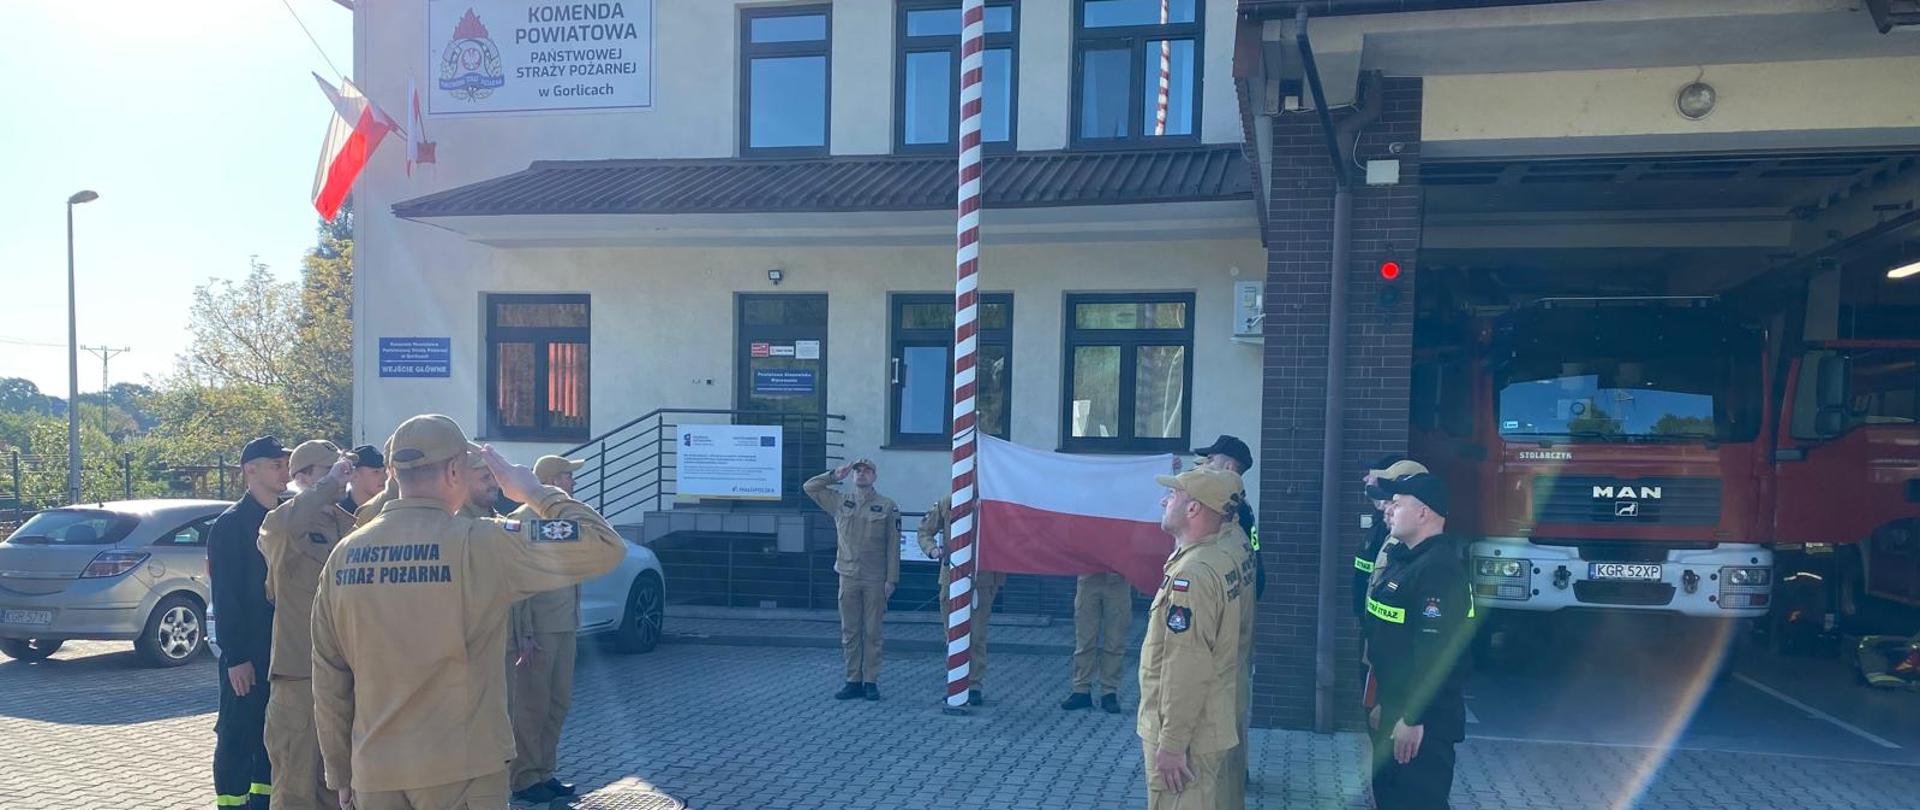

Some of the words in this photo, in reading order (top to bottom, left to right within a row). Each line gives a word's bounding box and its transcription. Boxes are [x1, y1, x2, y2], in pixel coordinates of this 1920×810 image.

[528, 2, 624, 23] KOMENDA
[515, 23, 637, 44] POWIATOWA
[530, 48, 622, 63] PAŃSTWOWEJ
[516, 64, 566, 79] STRAŻY
[569, 62, 636, 76] POŻARNEJ
[538, 88, 550, 97] w
[553, 83, 614, 97] Gorlicach
[1593, 486, 1661, 499] MAN
[346, 543, 439, 564] PAŃSTWOWA
[336, 567, 374, 586] STRAŻ
[380, 565, 451, 584] POŻARNA
[1597, 564, 1625, 577] KGR
[1627, 565, 1659, 577] 52XP
